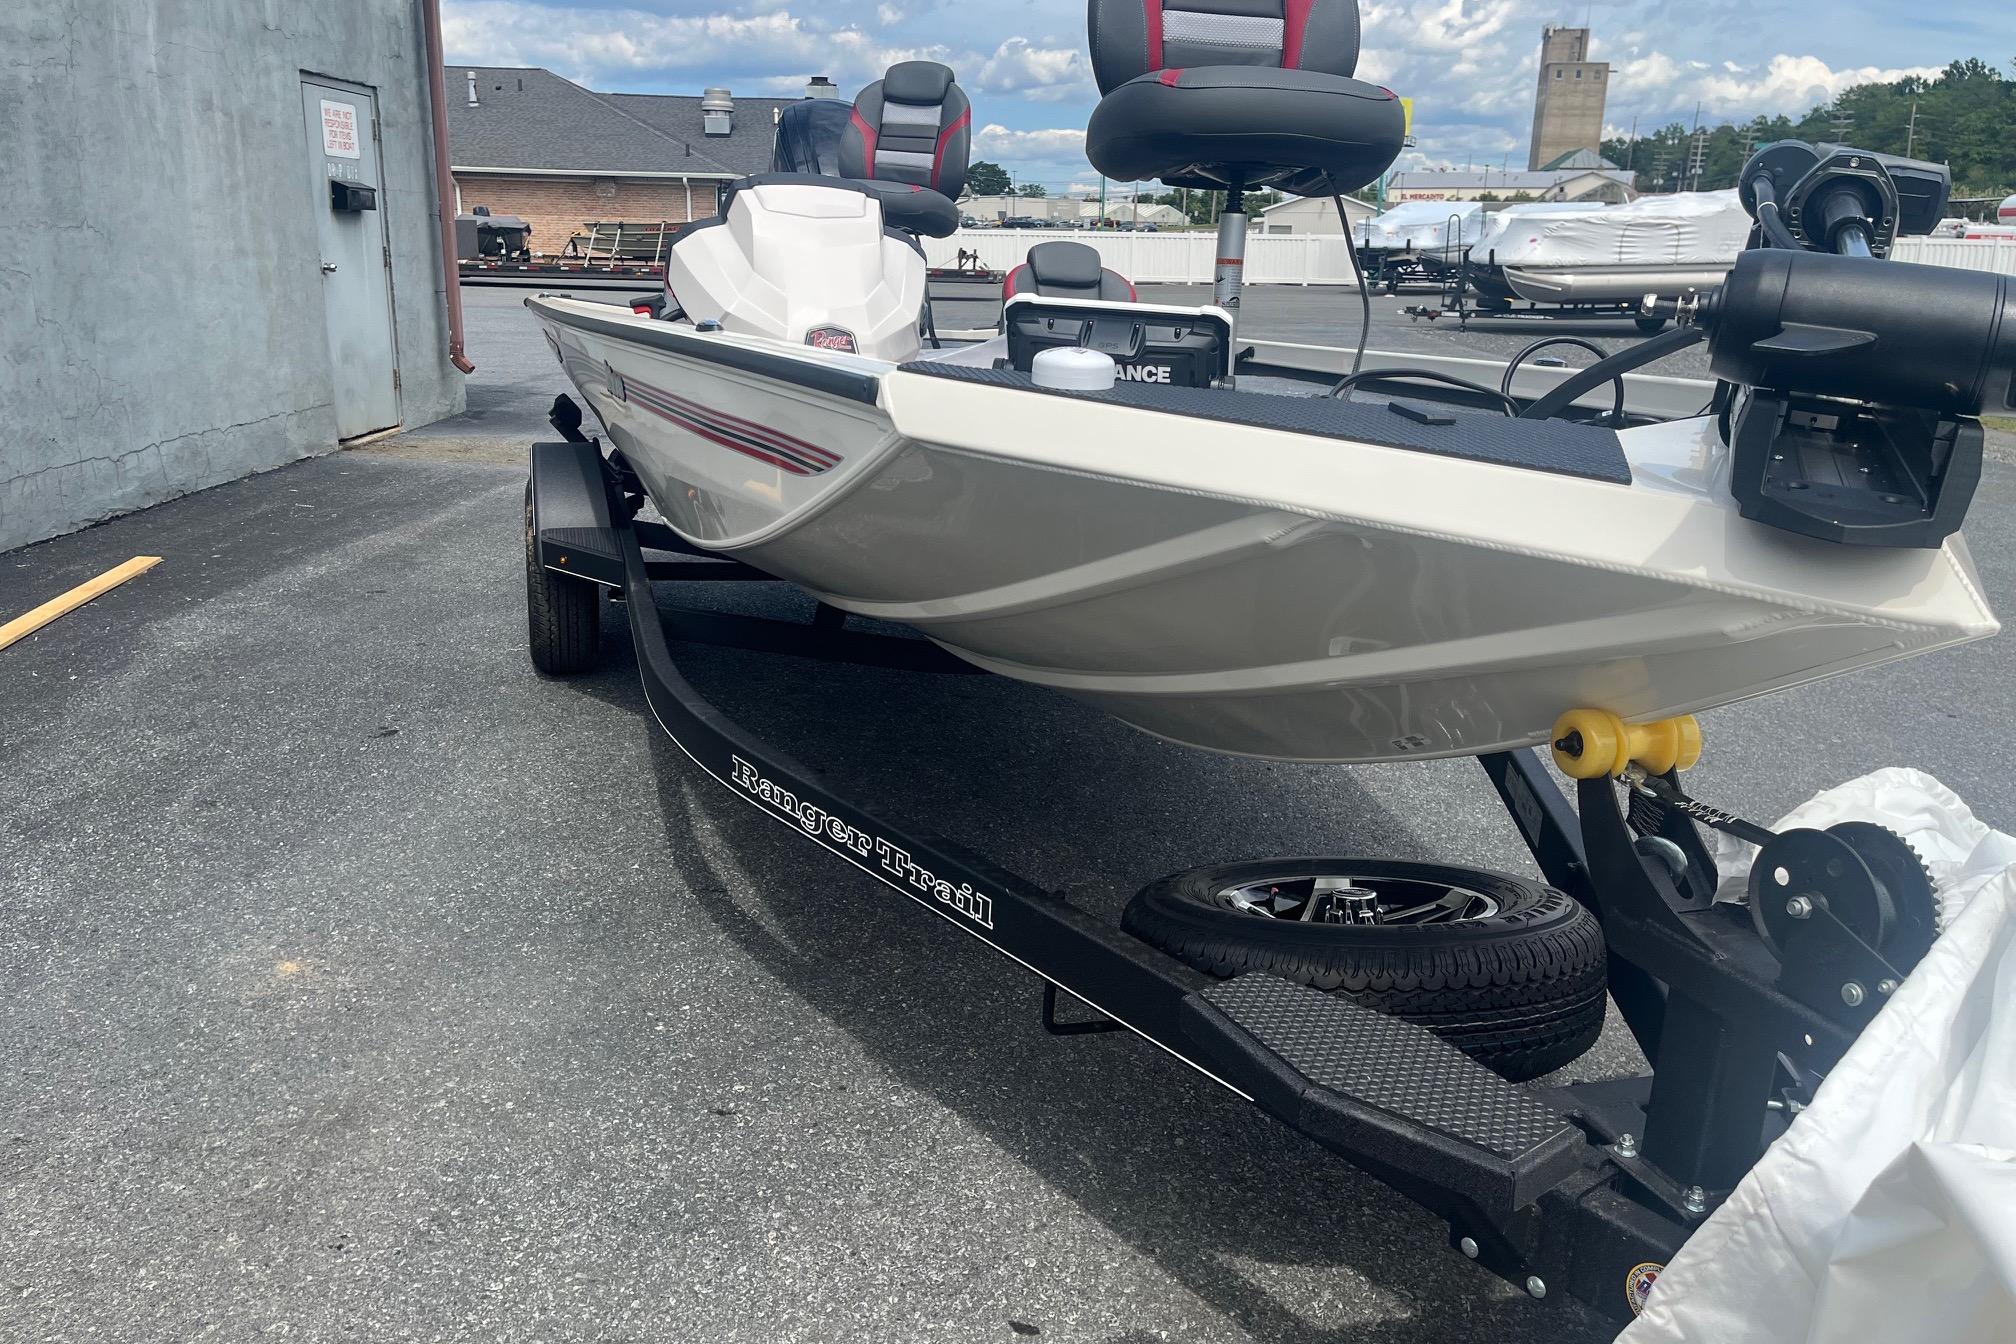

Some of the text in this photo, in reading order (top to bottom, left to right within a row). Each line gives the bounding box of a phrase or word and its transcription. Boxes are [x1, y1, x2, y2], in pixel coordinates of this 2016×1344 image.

[324, 108, 352, 120] WE ARE NOT
[324, 118, 353, 130] RESPONSIBLE
[329, 129, 352, 140] FOR ITEMS
[327, 139, 337, 149] LEFT
[343, 141, 355, 151] BOAT
[810, 331, 852, 350] Ranger
[1098, 342, 1119, 351] GPS
[1113, 364, 1171, 383] ANCE
[732, 754, 994, 930] Ranger Trail
